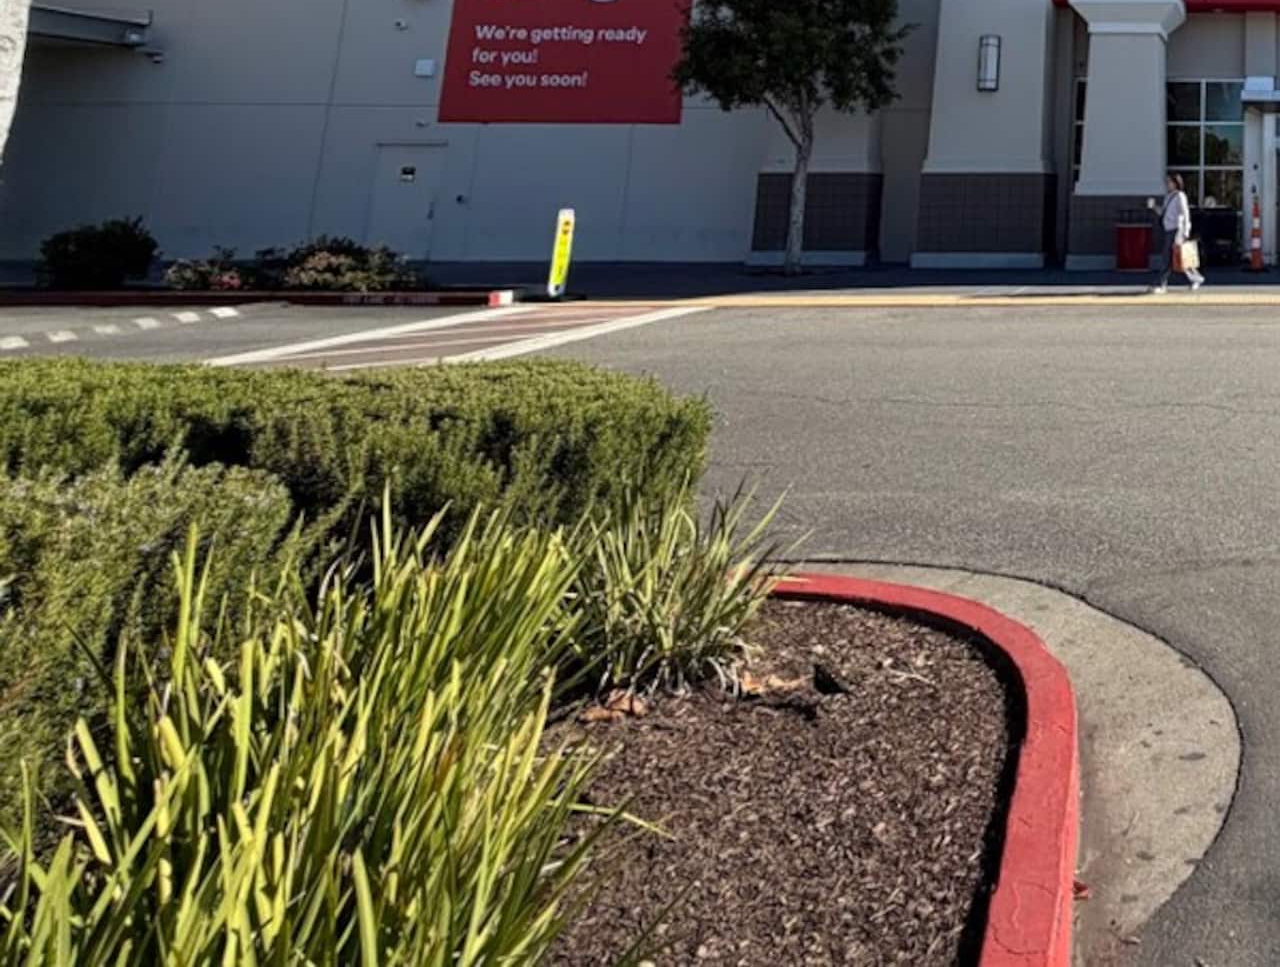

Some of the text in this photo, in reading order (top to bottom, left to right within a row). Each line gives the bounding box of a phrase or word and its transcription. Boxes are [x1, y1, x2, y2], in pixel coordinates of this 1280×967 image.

[475, 25, 648, 44] We're getting ready
[471, 47, 539, 66] for you!
[469, 70, 588, 88] See you soon!
